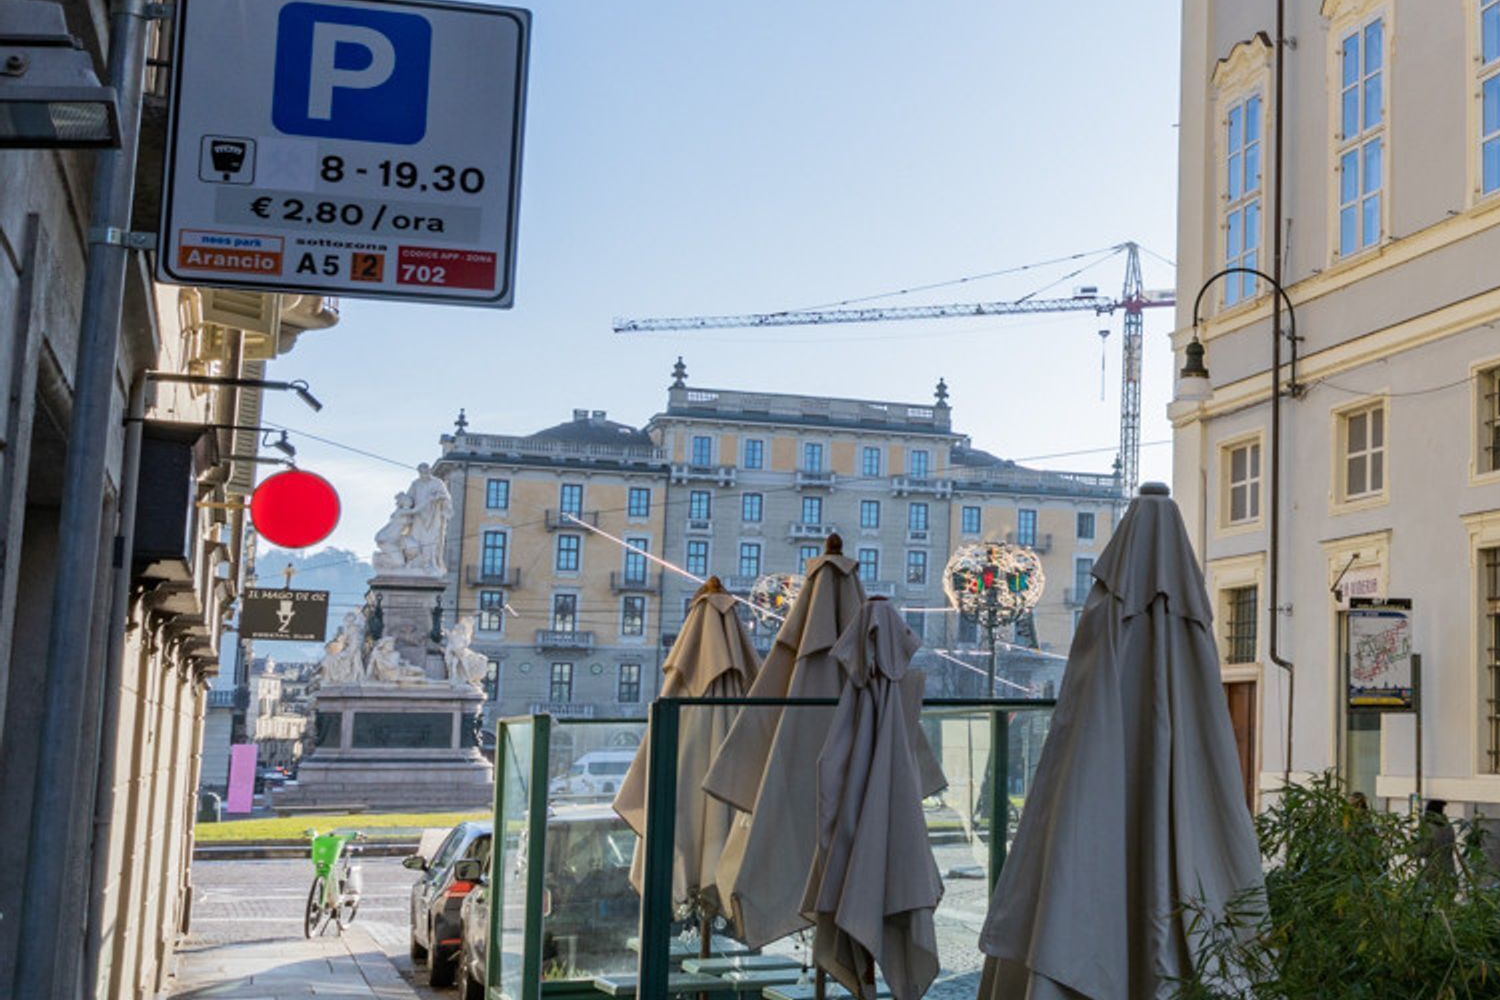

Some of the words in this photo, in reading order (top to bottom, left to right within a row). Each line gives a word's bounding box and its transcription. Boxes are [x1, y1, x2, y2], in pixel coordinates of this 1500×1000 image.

[307, 21, 397, 120] P
[320, 155, 344, 183] 8
[379, 160, 485, 194] 19.30
[251, 197, 273, 219] €
[296, 238, 387, 250] sottozona
[187, 249, 275, 270] Arancio
[362, 254, 377, 277] 2
[402, 249, 438, 260] CODICE
[440, 252, 460, 261] APP
[466, 254, 493, 263] ZONA
[402, 264, 446, 283] 702
[262, 591, 293, 600] MAGO
